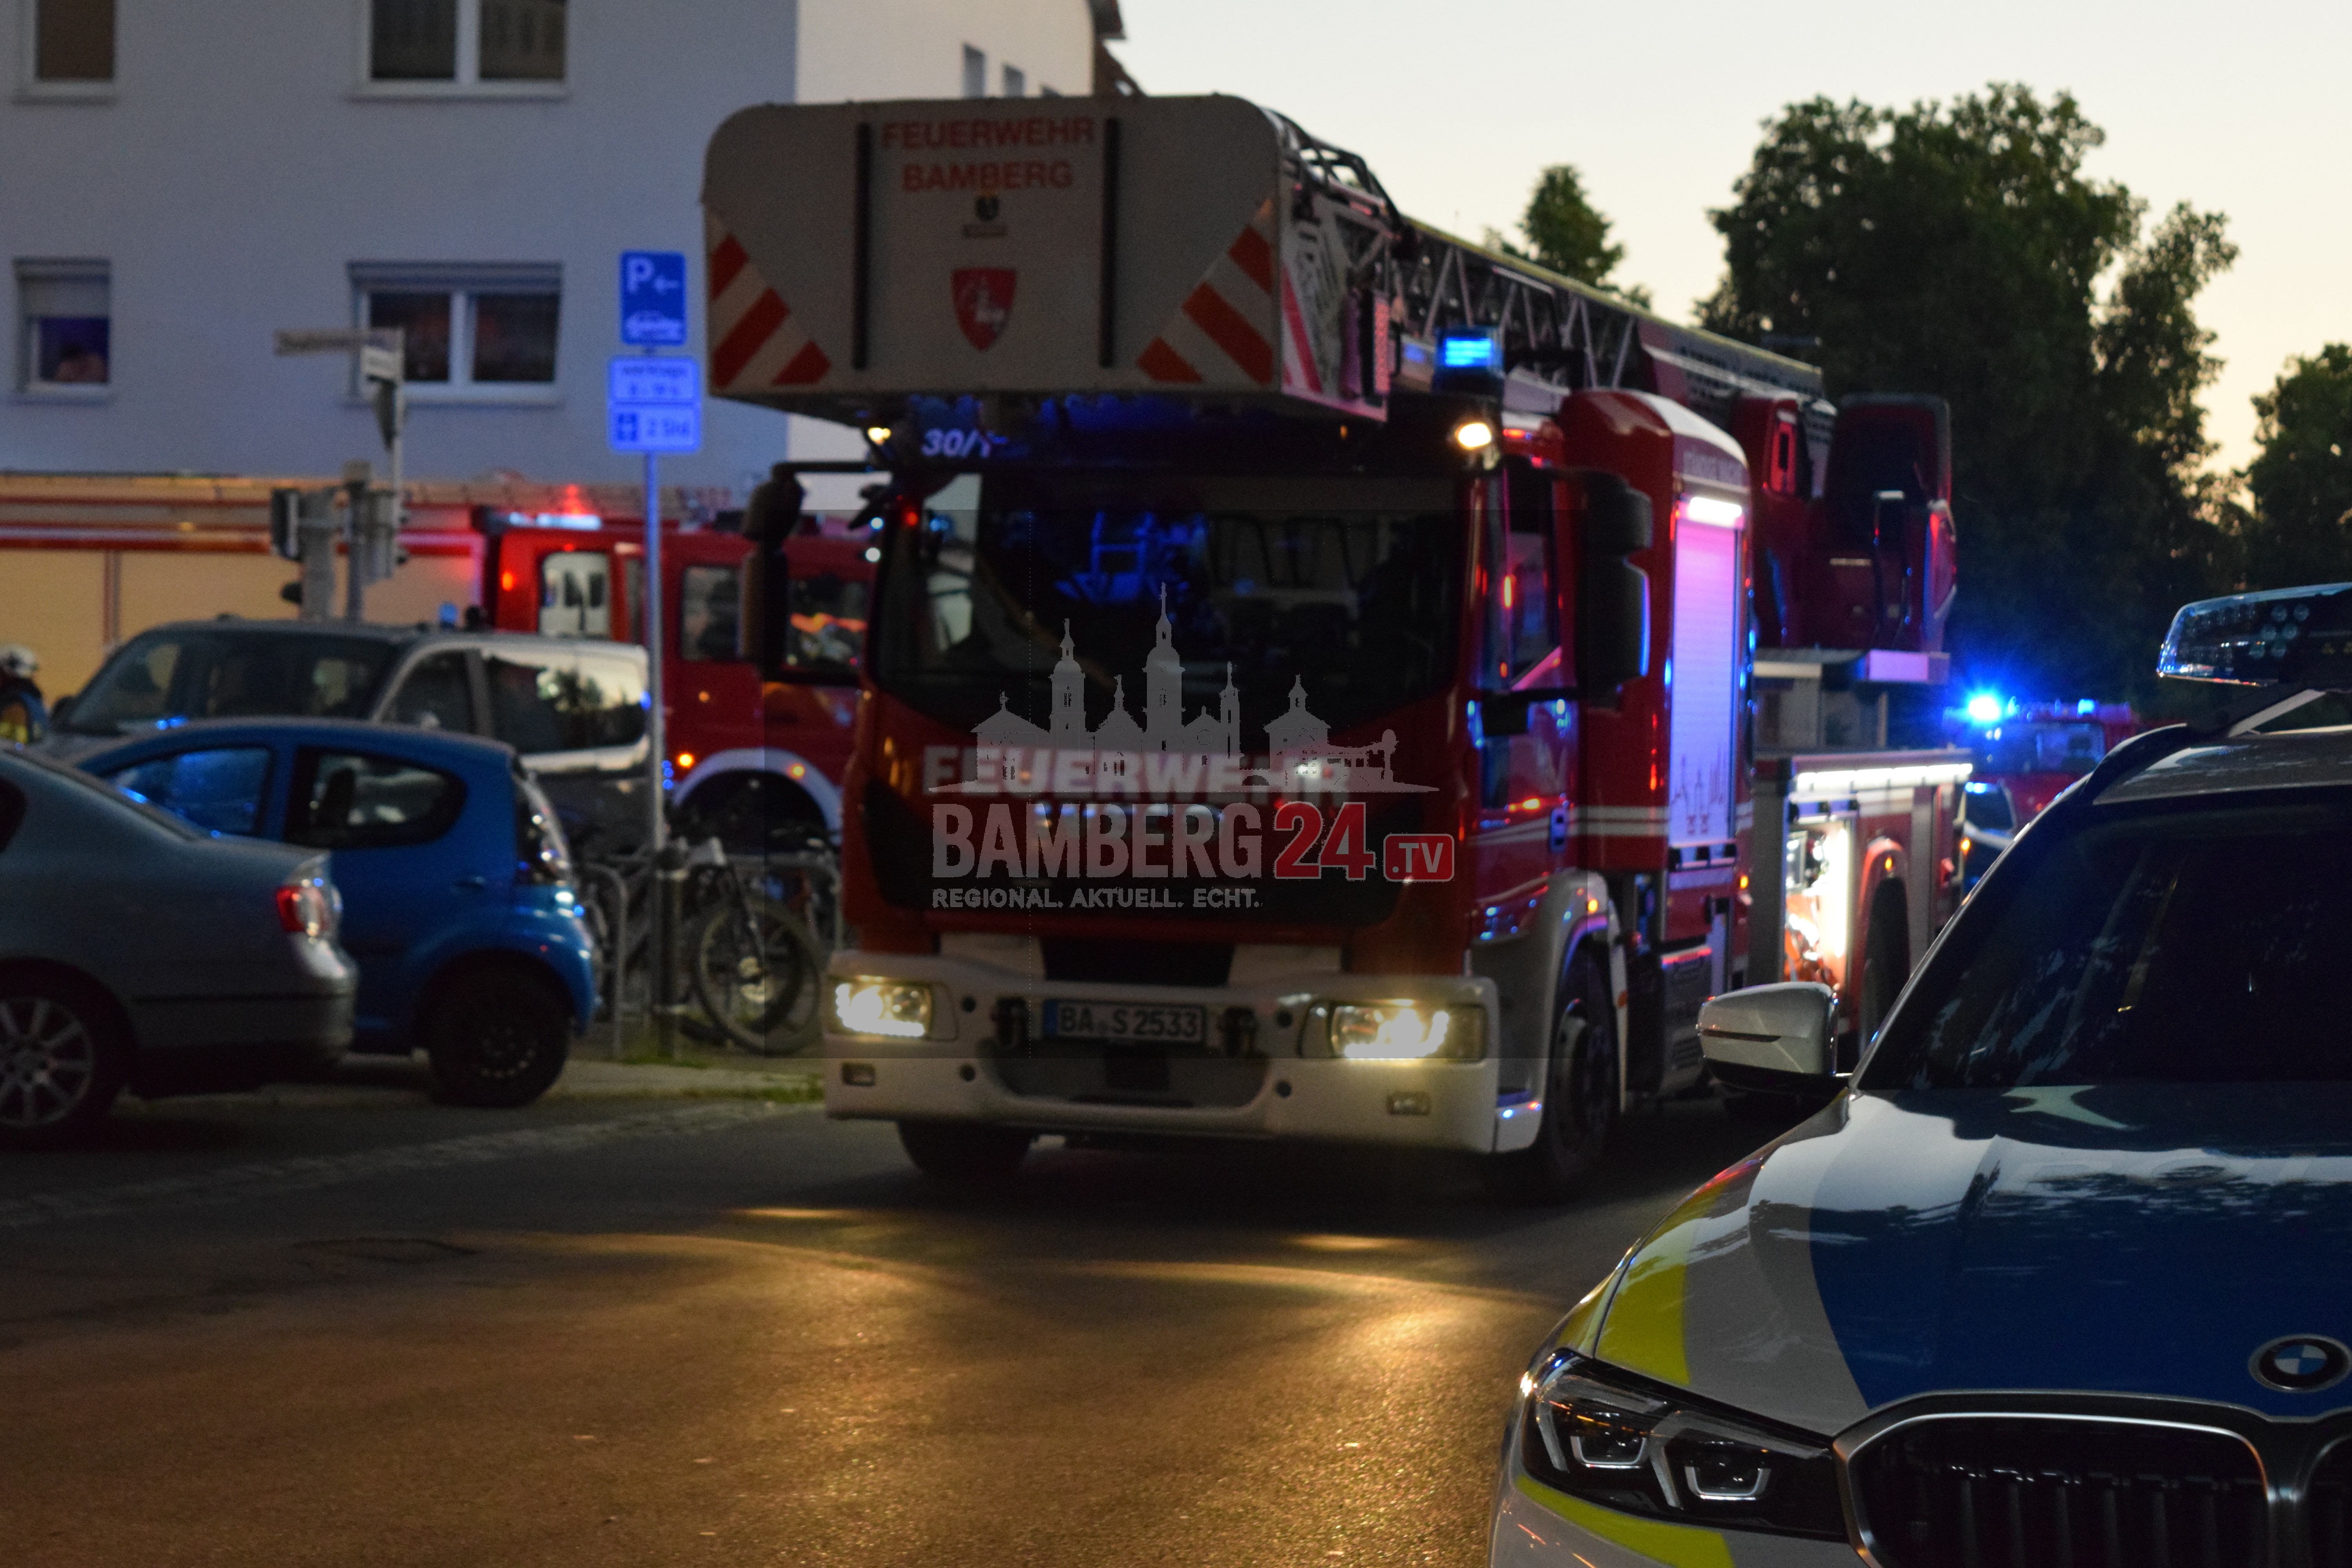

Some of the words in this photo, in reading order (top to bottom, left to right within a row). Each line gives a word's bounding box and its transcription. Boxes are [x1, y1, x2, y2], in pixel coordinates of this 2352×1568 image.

[881, 118, 1094, 149] FEUERWEHR
[902, 160, 1074, 192] BAMBERG
[923, 746, 1352, 805] FEUERWEHR
[1061, 1007, 1094, 1032] BA
[1134, 1010, 1197, 1037] 2533
